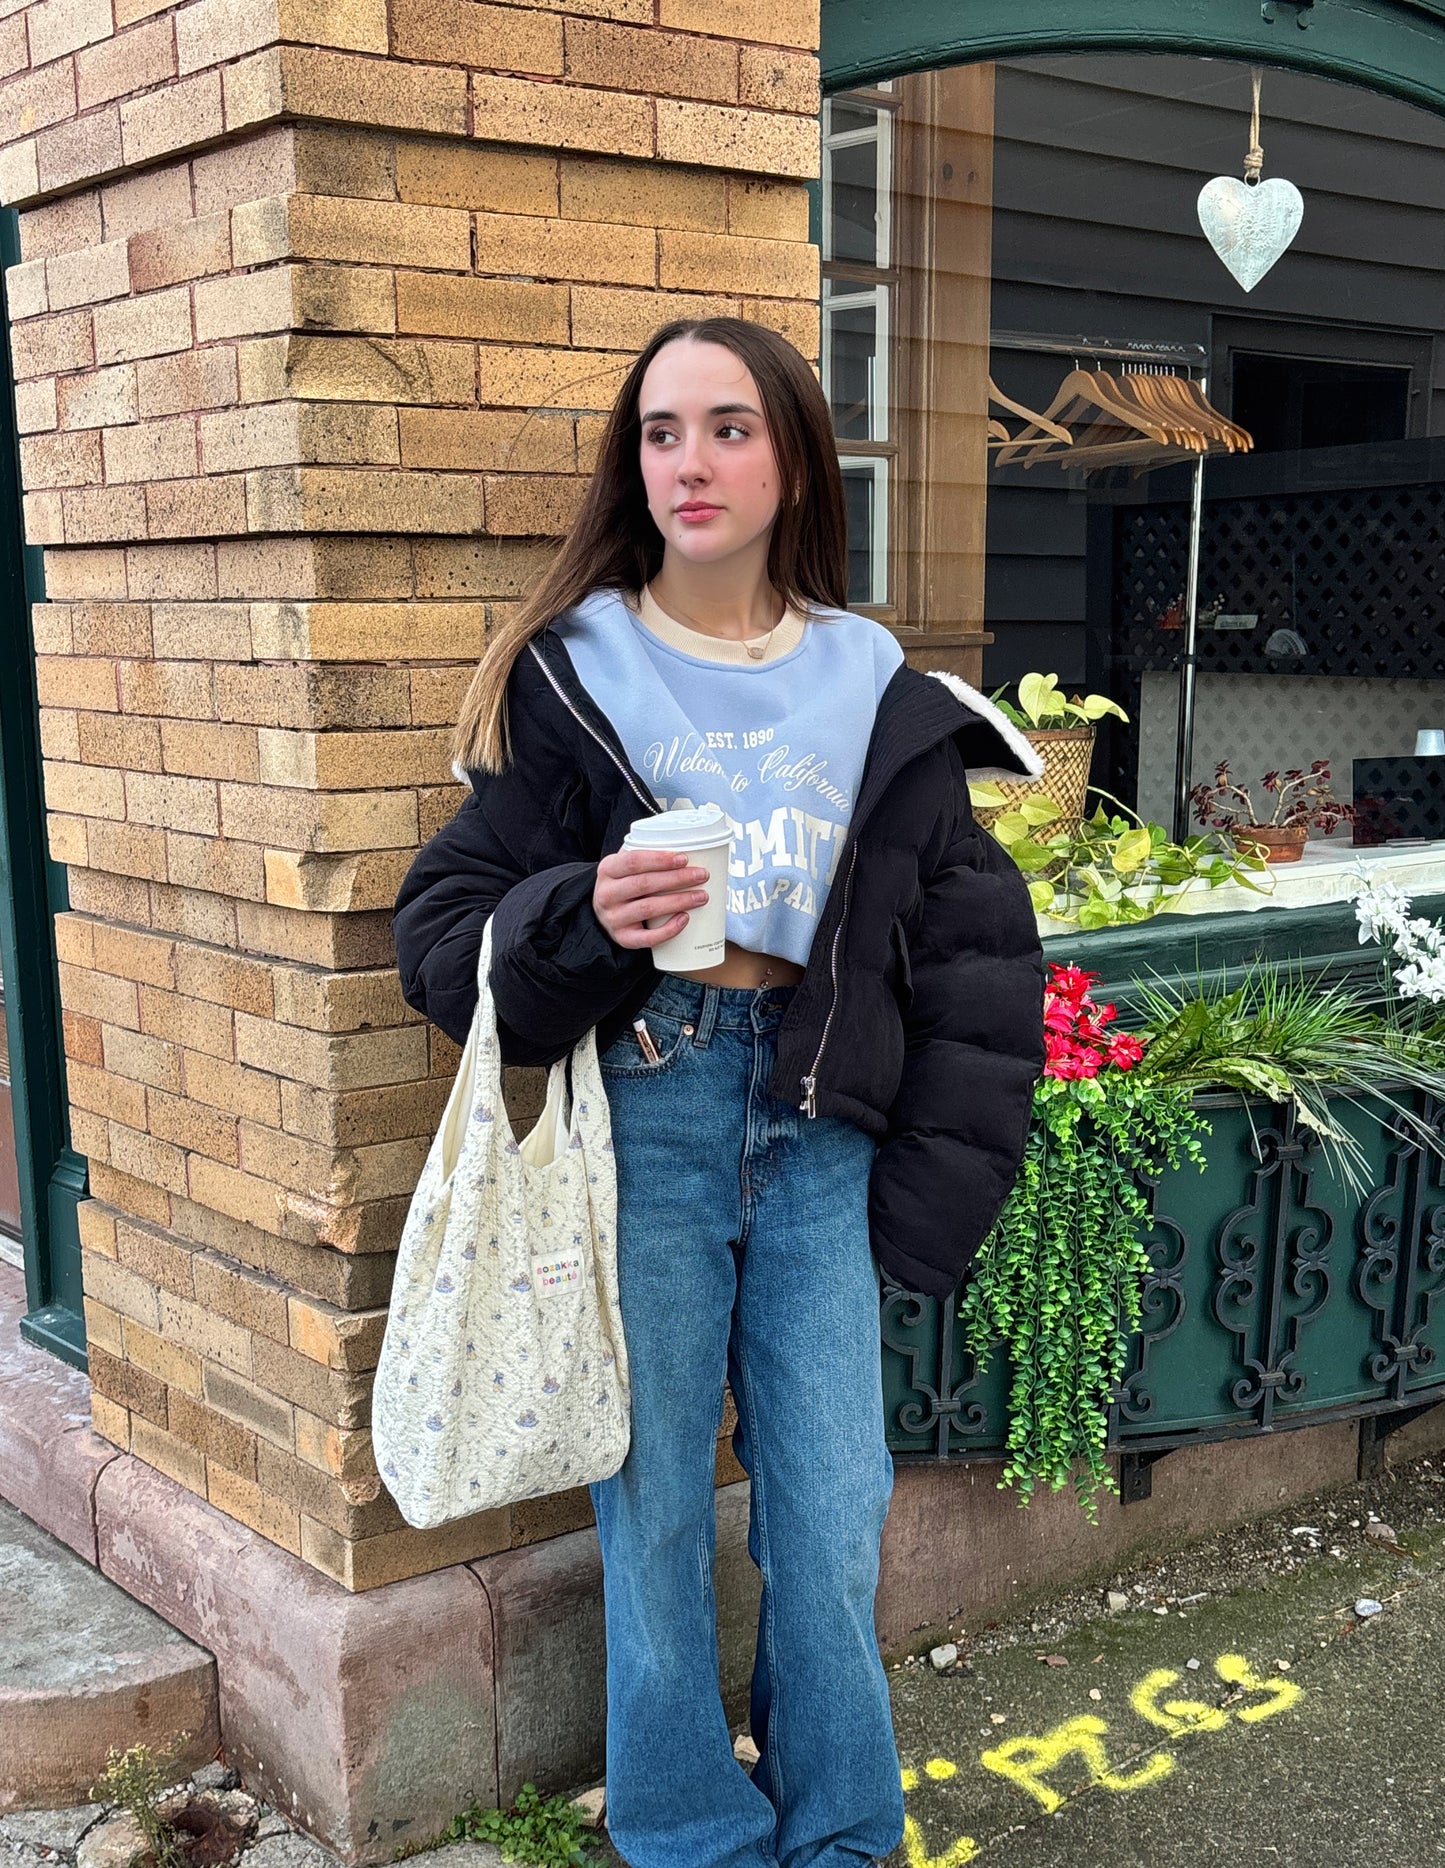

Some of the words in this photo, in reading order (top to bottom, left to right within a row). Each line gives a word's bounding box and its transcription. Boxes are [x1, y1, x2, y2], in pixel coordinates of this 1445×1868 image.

[705, 731, 738, 750] EST.
[742, 727, 775, 750] 1890
[730, 770, 753, 793] to
[757, 744, 850, 812] California
